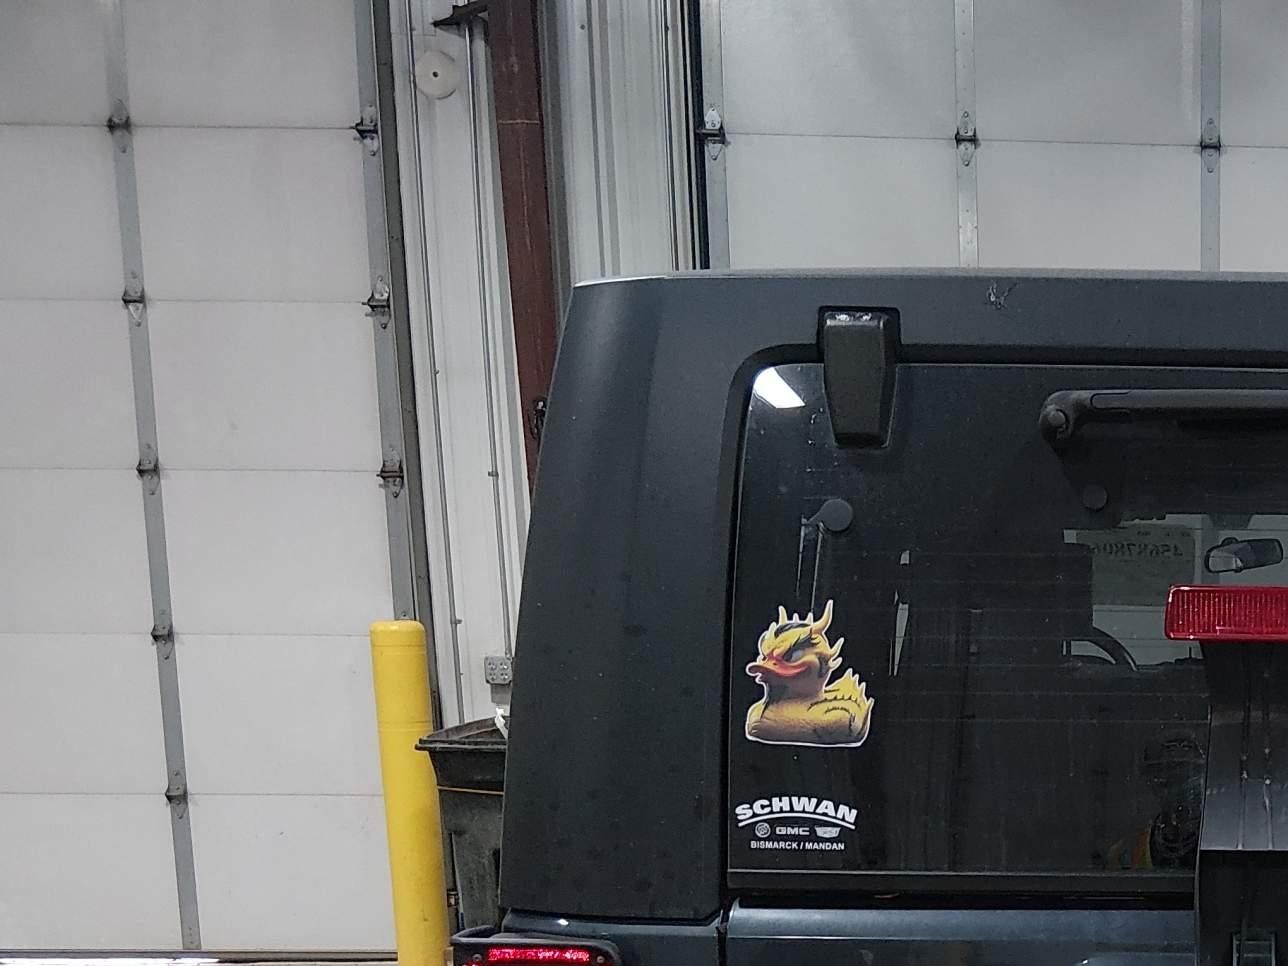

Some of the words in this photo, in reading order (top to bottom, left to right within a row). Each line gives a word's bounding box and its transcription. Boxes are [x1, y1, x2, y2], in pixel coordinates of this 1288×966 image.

[735, 796, 858, 824] SCHWAN
[775, 826, 811, 836] GMC
[750, 840, 799, 850] BISMARCK
[800, 841, 804, 850] /
[805, 842, 845, 851] MANDAN
